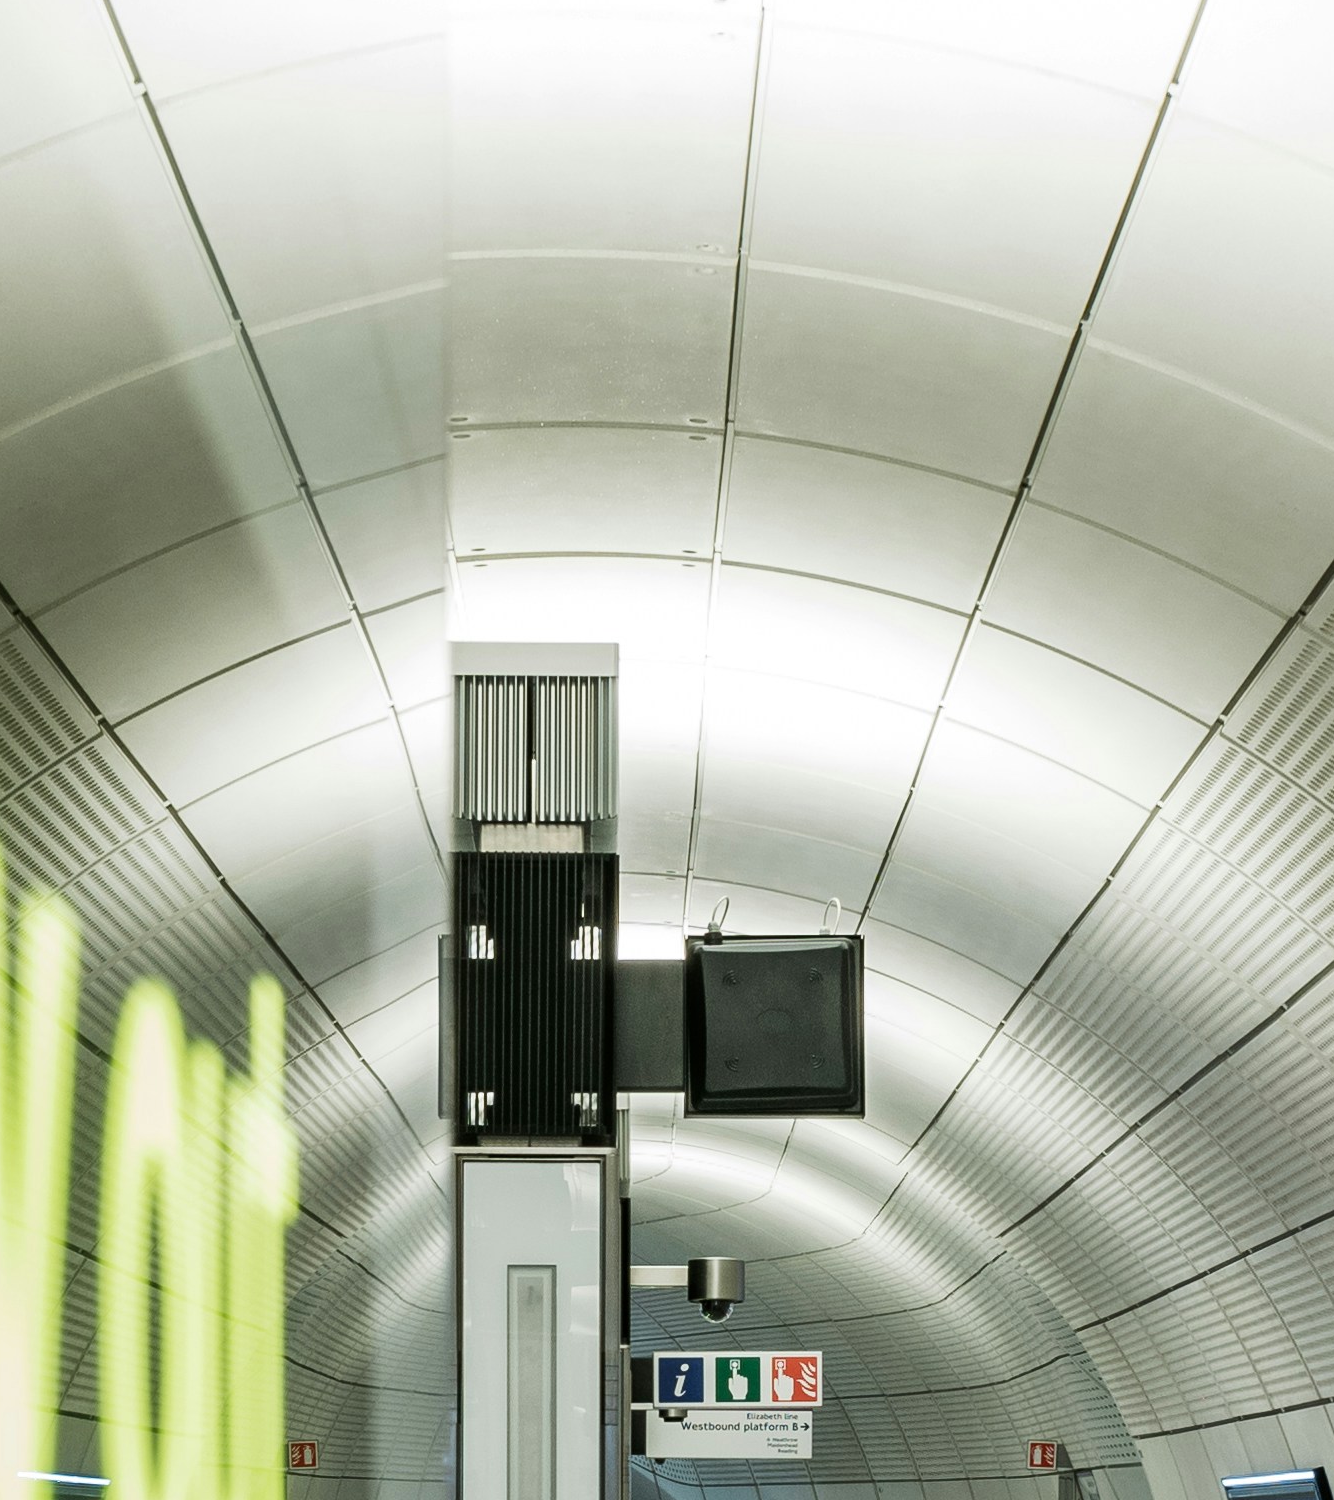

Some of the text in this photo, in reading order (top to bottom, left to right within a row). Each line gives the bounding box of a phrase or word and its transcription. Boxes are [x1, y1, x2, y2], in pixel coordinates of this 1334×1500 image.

[681, 1422, 799, 1433] Westbound platform B
